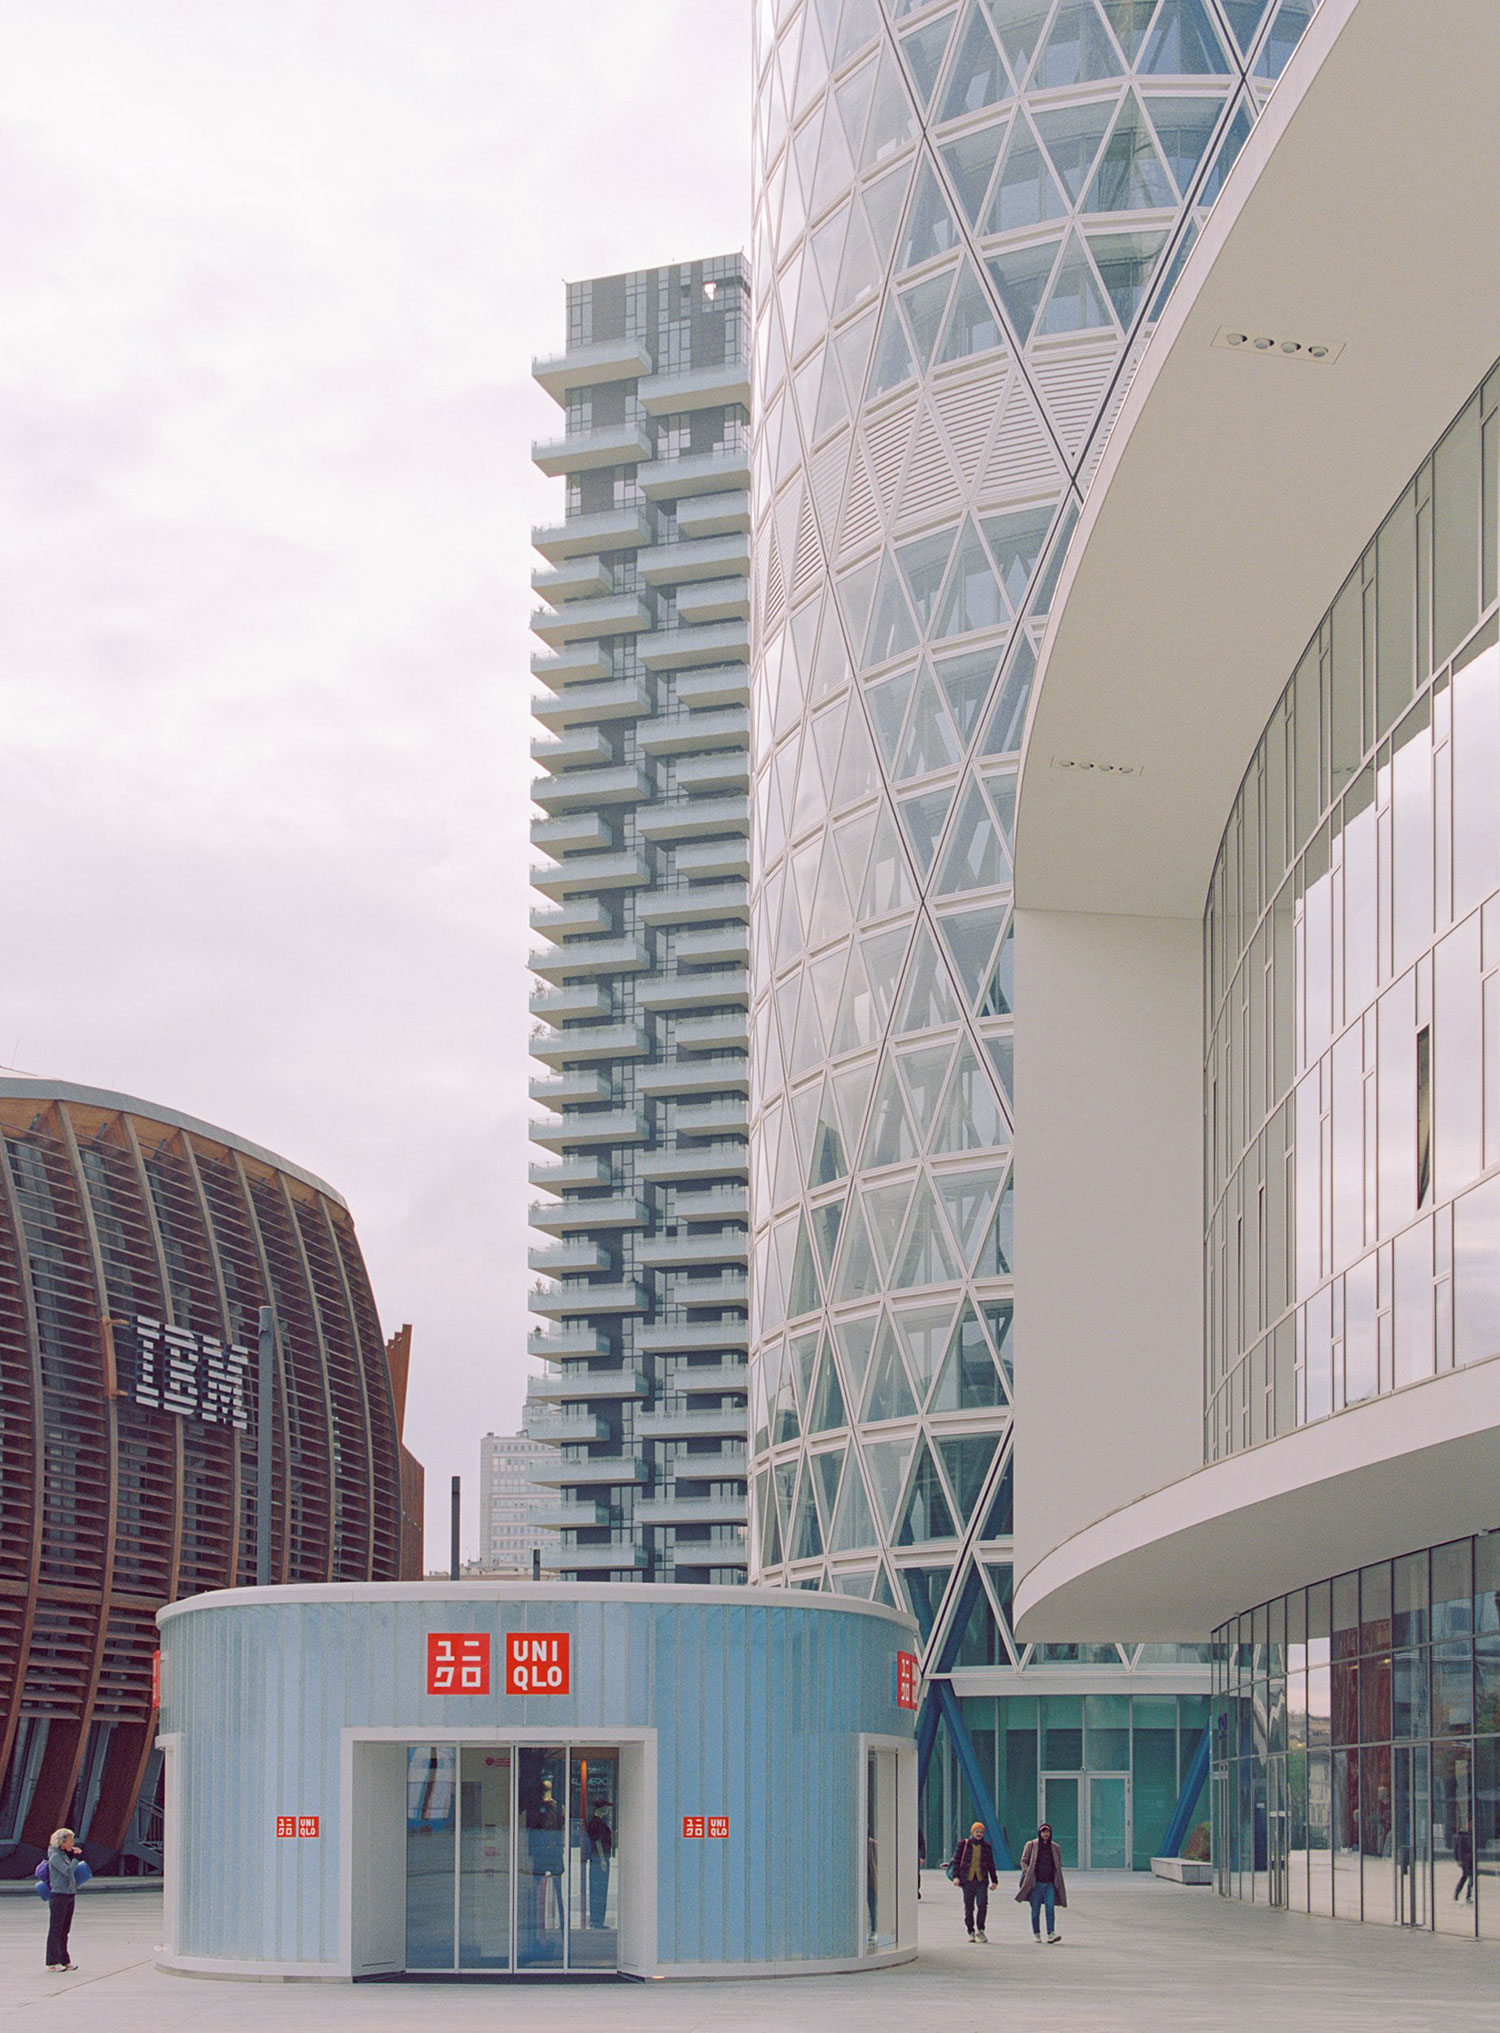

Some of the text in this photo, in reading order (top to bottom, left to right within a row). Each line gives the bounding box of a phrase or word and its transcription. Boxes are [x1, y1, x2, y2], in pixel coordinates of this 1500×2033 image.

[136, 1315, 248, 1430] IBM
[436, 1640, 481, 1661] ユニ
[513, 1640, 558, 1662] UNI
[433, 1666, 481, 1687] クロ
[513, 1666, 562, 1691] QLO
[300, 1818, 315, 1827] UNI
[686, 1818, 703, 1827] ユニ
[710, 1818, 726, 1827] UNI
[300, 1827, 316, 1837] QLO
[685, 1827, 703, 1836] クロ
[710, 1827, 728, 1837] QLO
